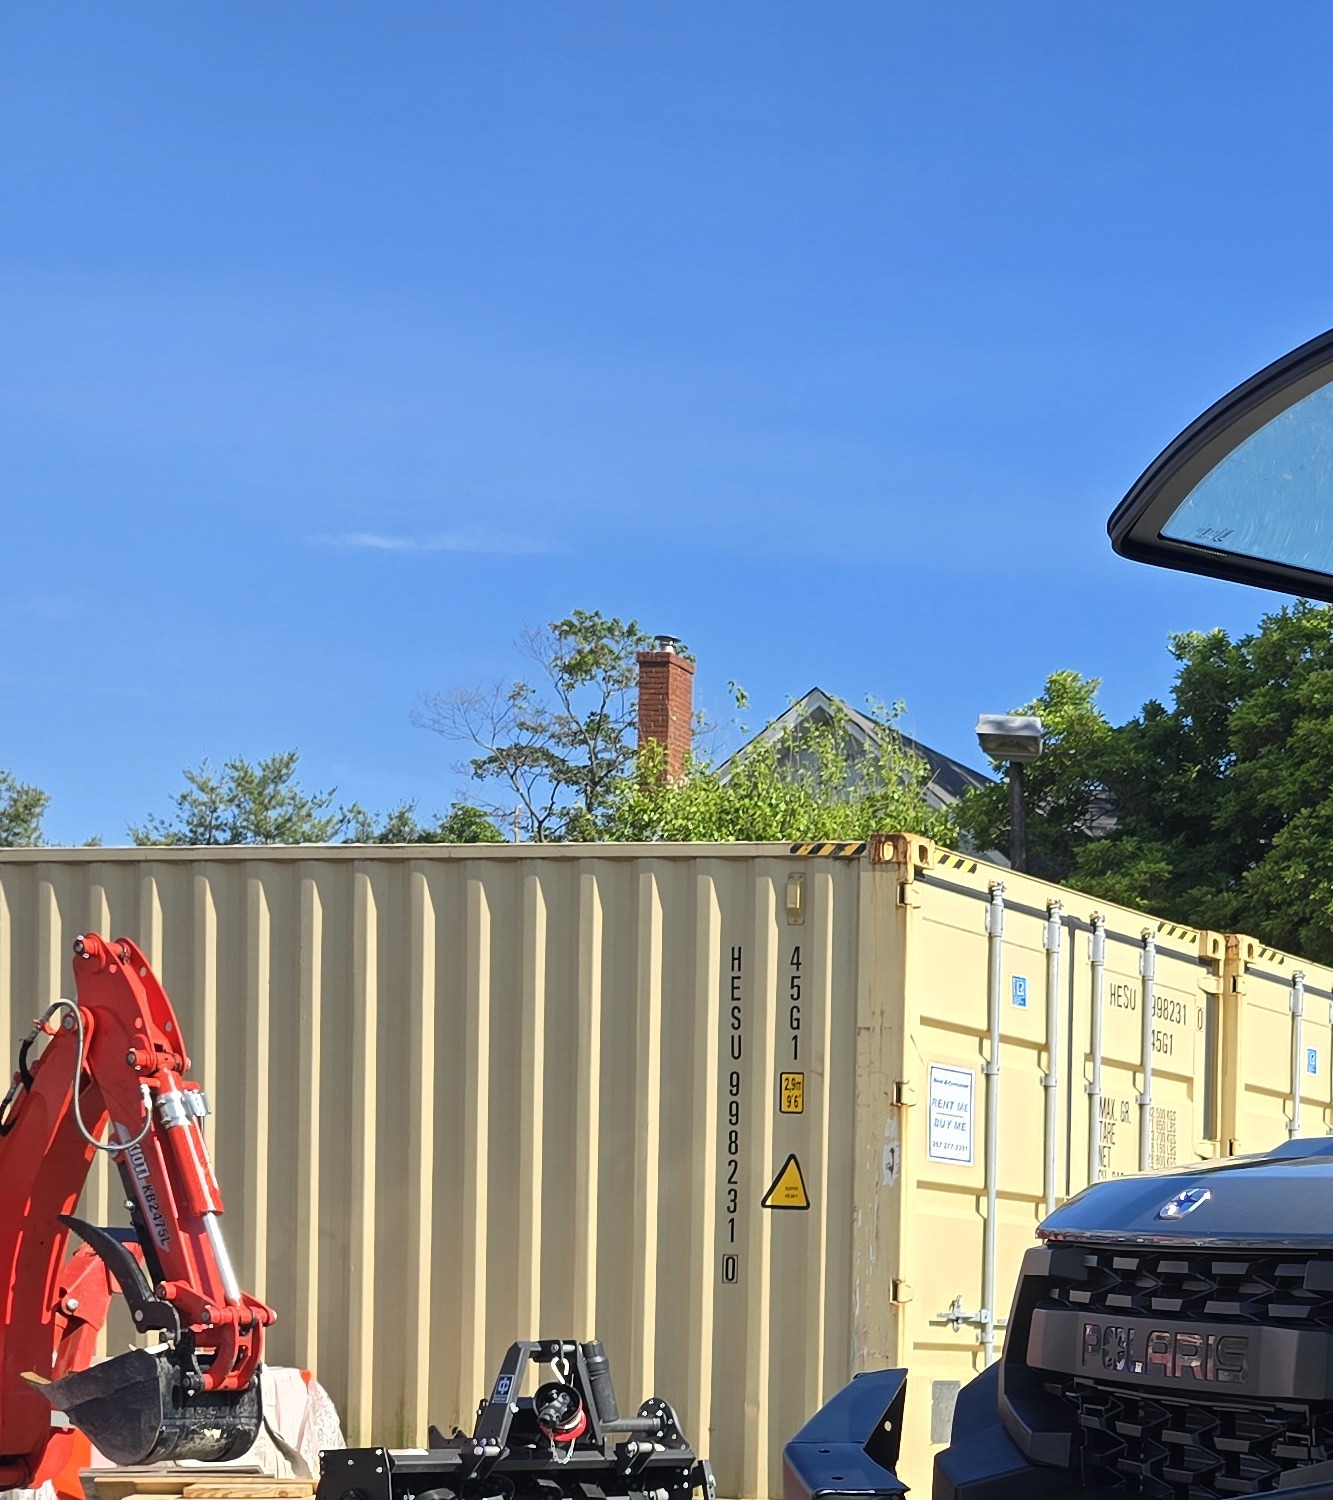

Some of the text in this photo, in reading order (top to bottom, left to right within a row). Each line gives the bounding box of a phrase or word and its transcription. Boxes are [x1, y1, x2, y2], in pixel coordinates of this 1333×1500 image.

[730, 946, 742, 1060] HESU
[790, 946, 802, 1060] 45G1
[1109, 983, 1136, 1011] HESU
[931, 1098, 969, 1112] RENT ME
[933, 1117, 966, 1131] BUY ME
[727, 1071, 740, 1243] 998231
[1081, 1322, 1249, 1383] POLARIS
